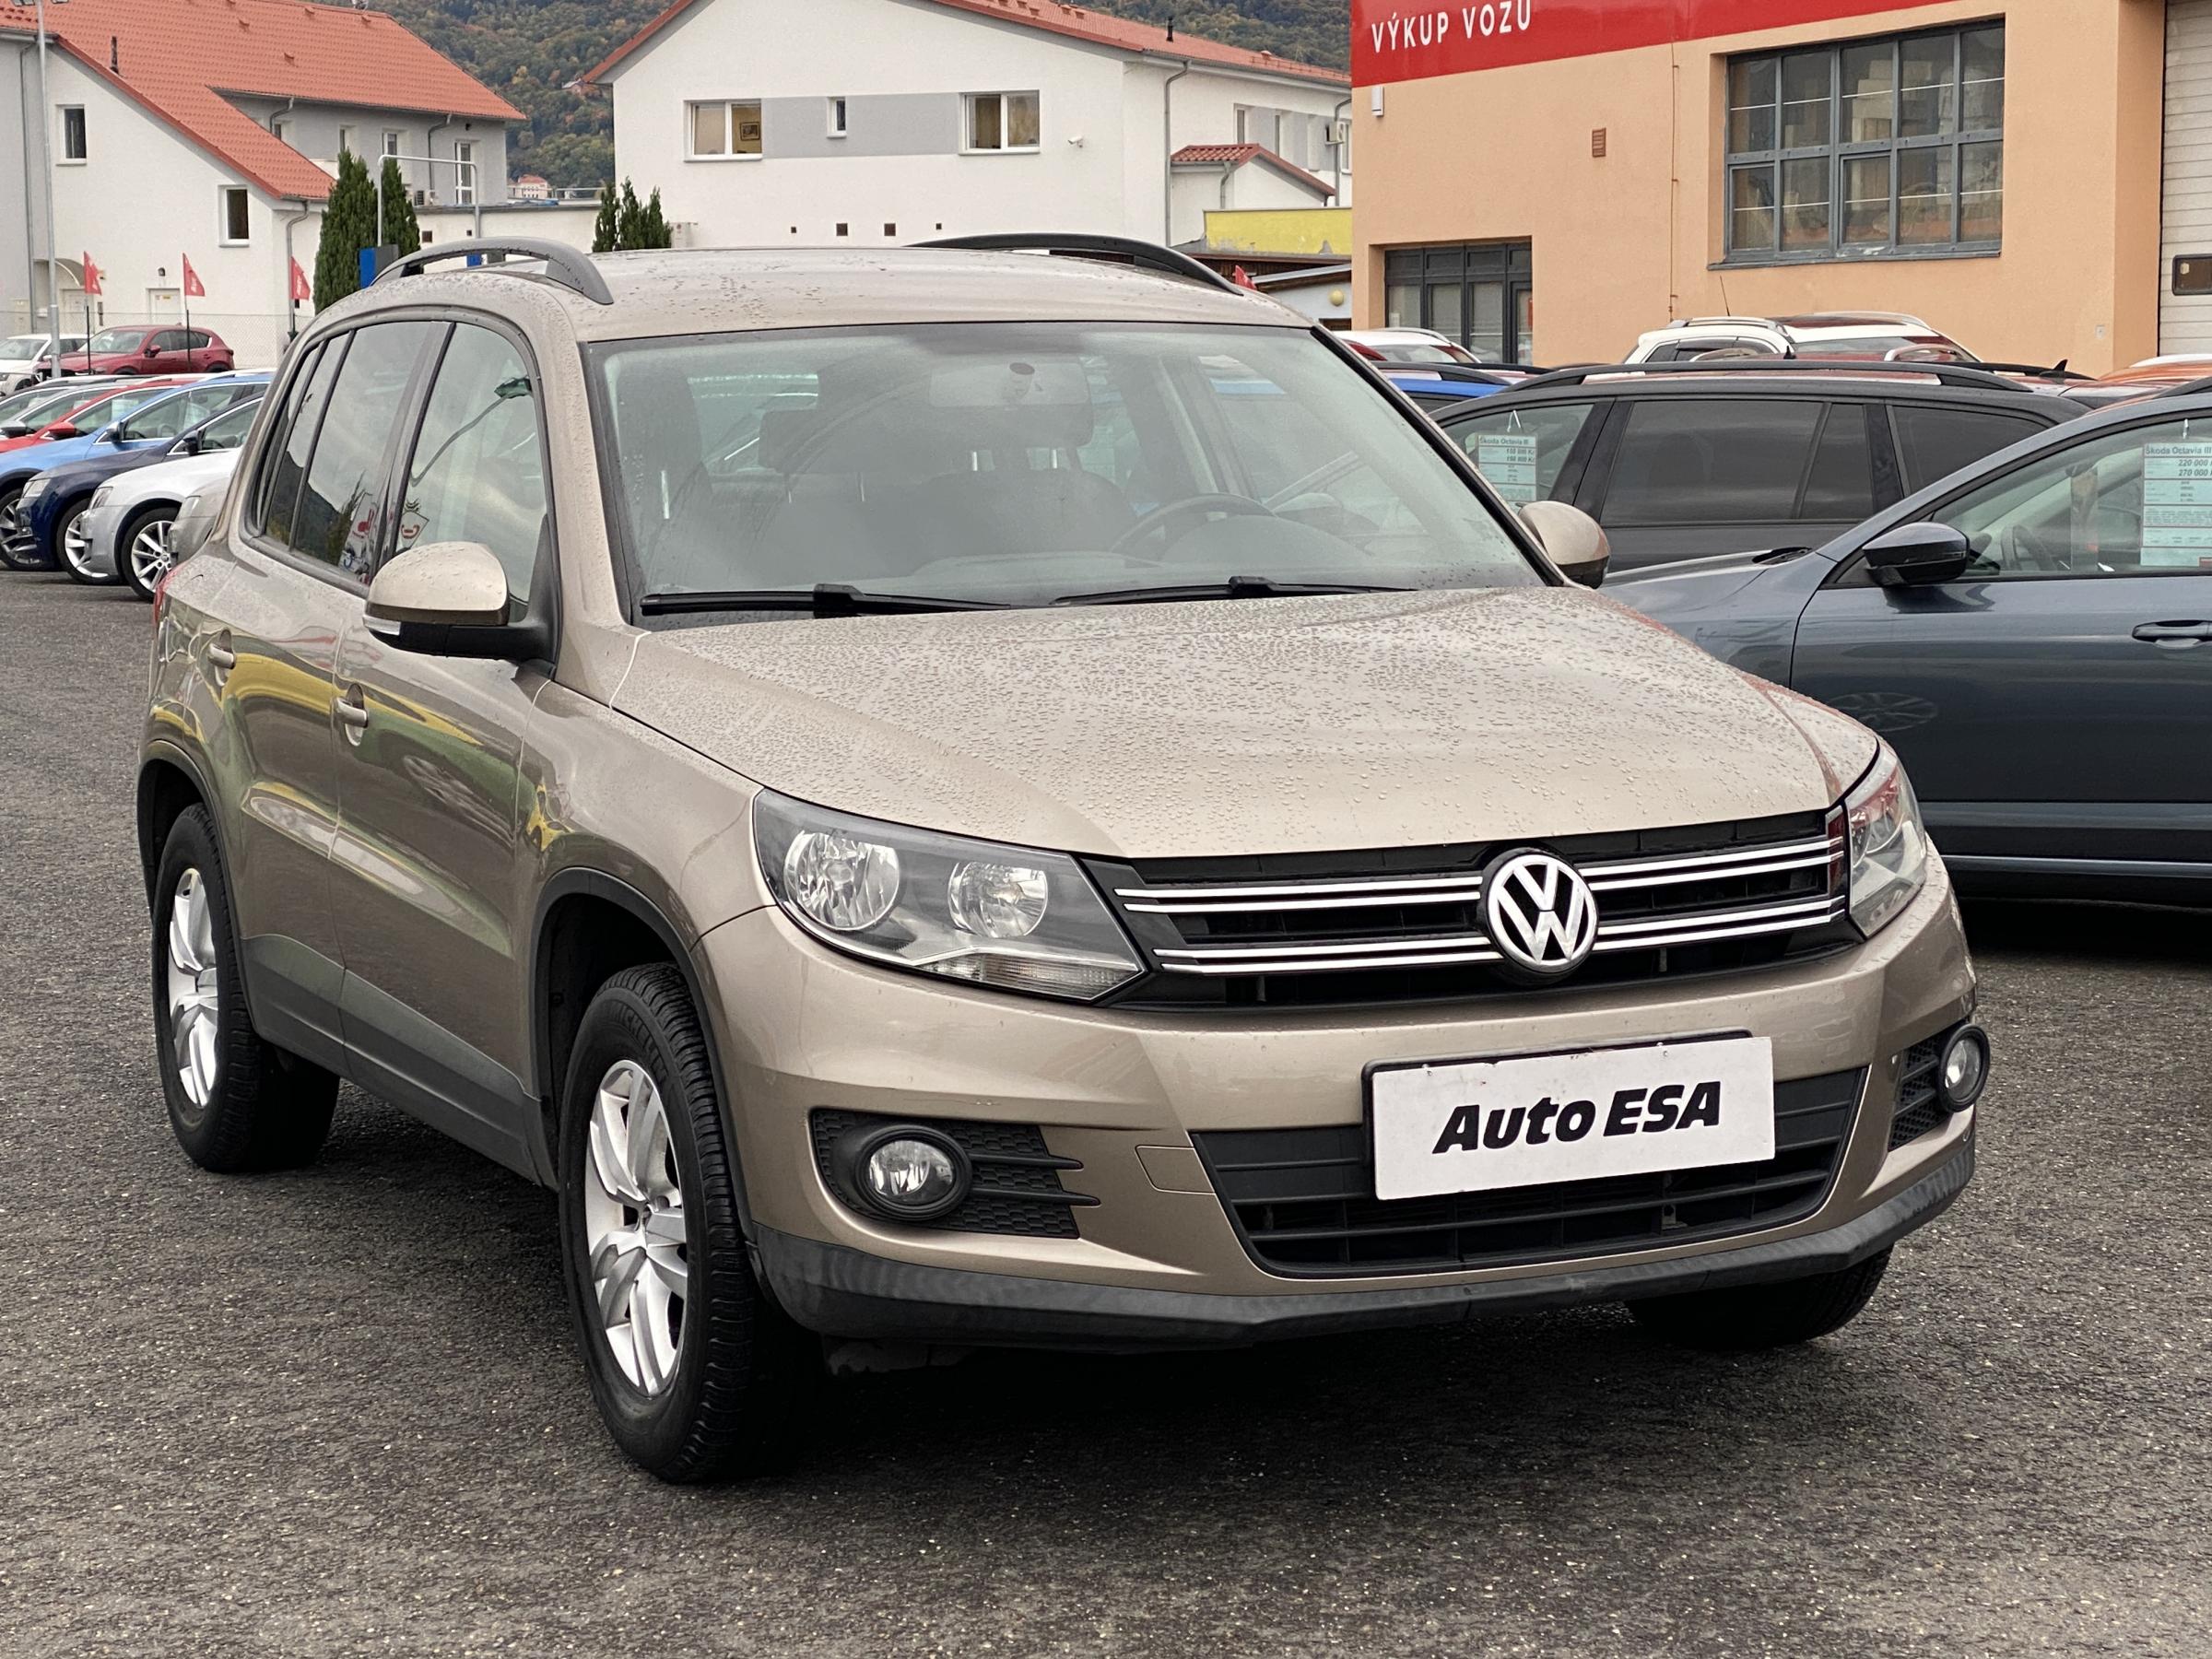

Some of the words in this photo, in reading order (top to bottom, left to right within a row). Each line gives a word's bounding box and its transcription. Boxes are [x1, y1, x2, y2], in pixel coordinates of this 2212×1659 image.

[1371, 12, 1450, 53] VÝKUP
[2171, 446, 2202, 454] Octavia
[1431, 1097, 1596, 1154] Auto
[1603, 1080, 1722, 1137] ESA
